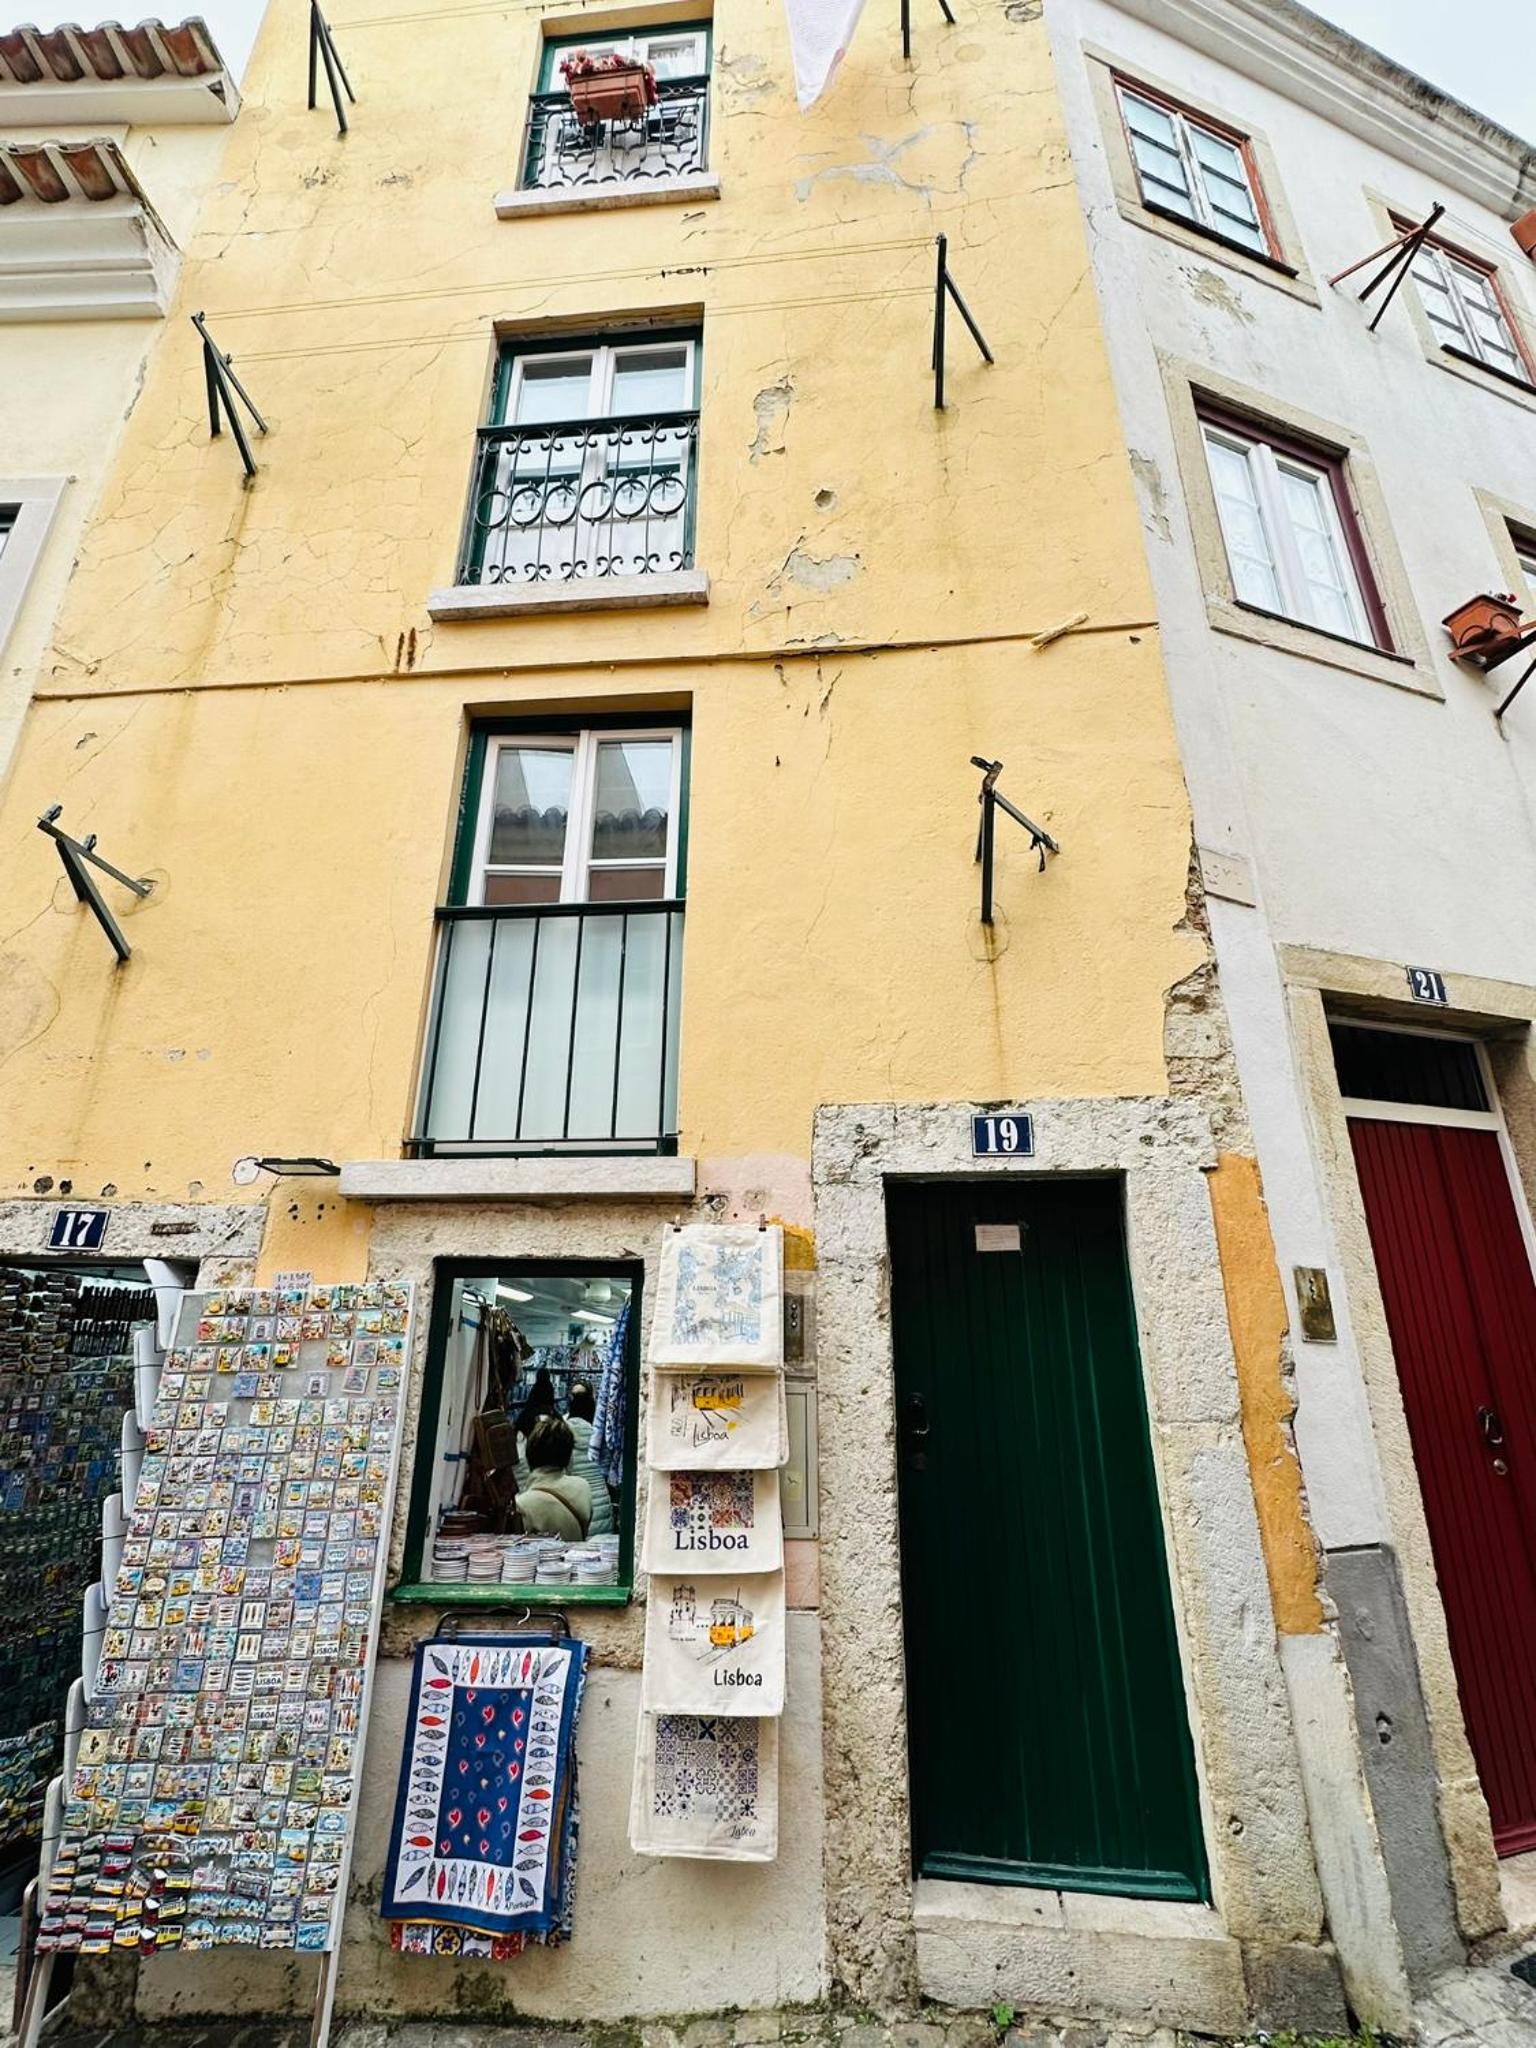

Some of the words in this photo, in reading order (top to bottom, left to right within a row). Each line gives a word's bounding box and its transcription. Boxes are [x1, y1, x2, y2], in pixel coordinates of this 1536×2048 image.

[1415, 971, 1441, 1000] 21
[984, 1118, 1018, 1152] 19
[60, 1212, 96, 1246] 17
[693, 1424, 730, 1448] Lisboa
[675, 1529, 749, 1550] Lisboa
[714, 1667, 763, 1686] Lisboa
